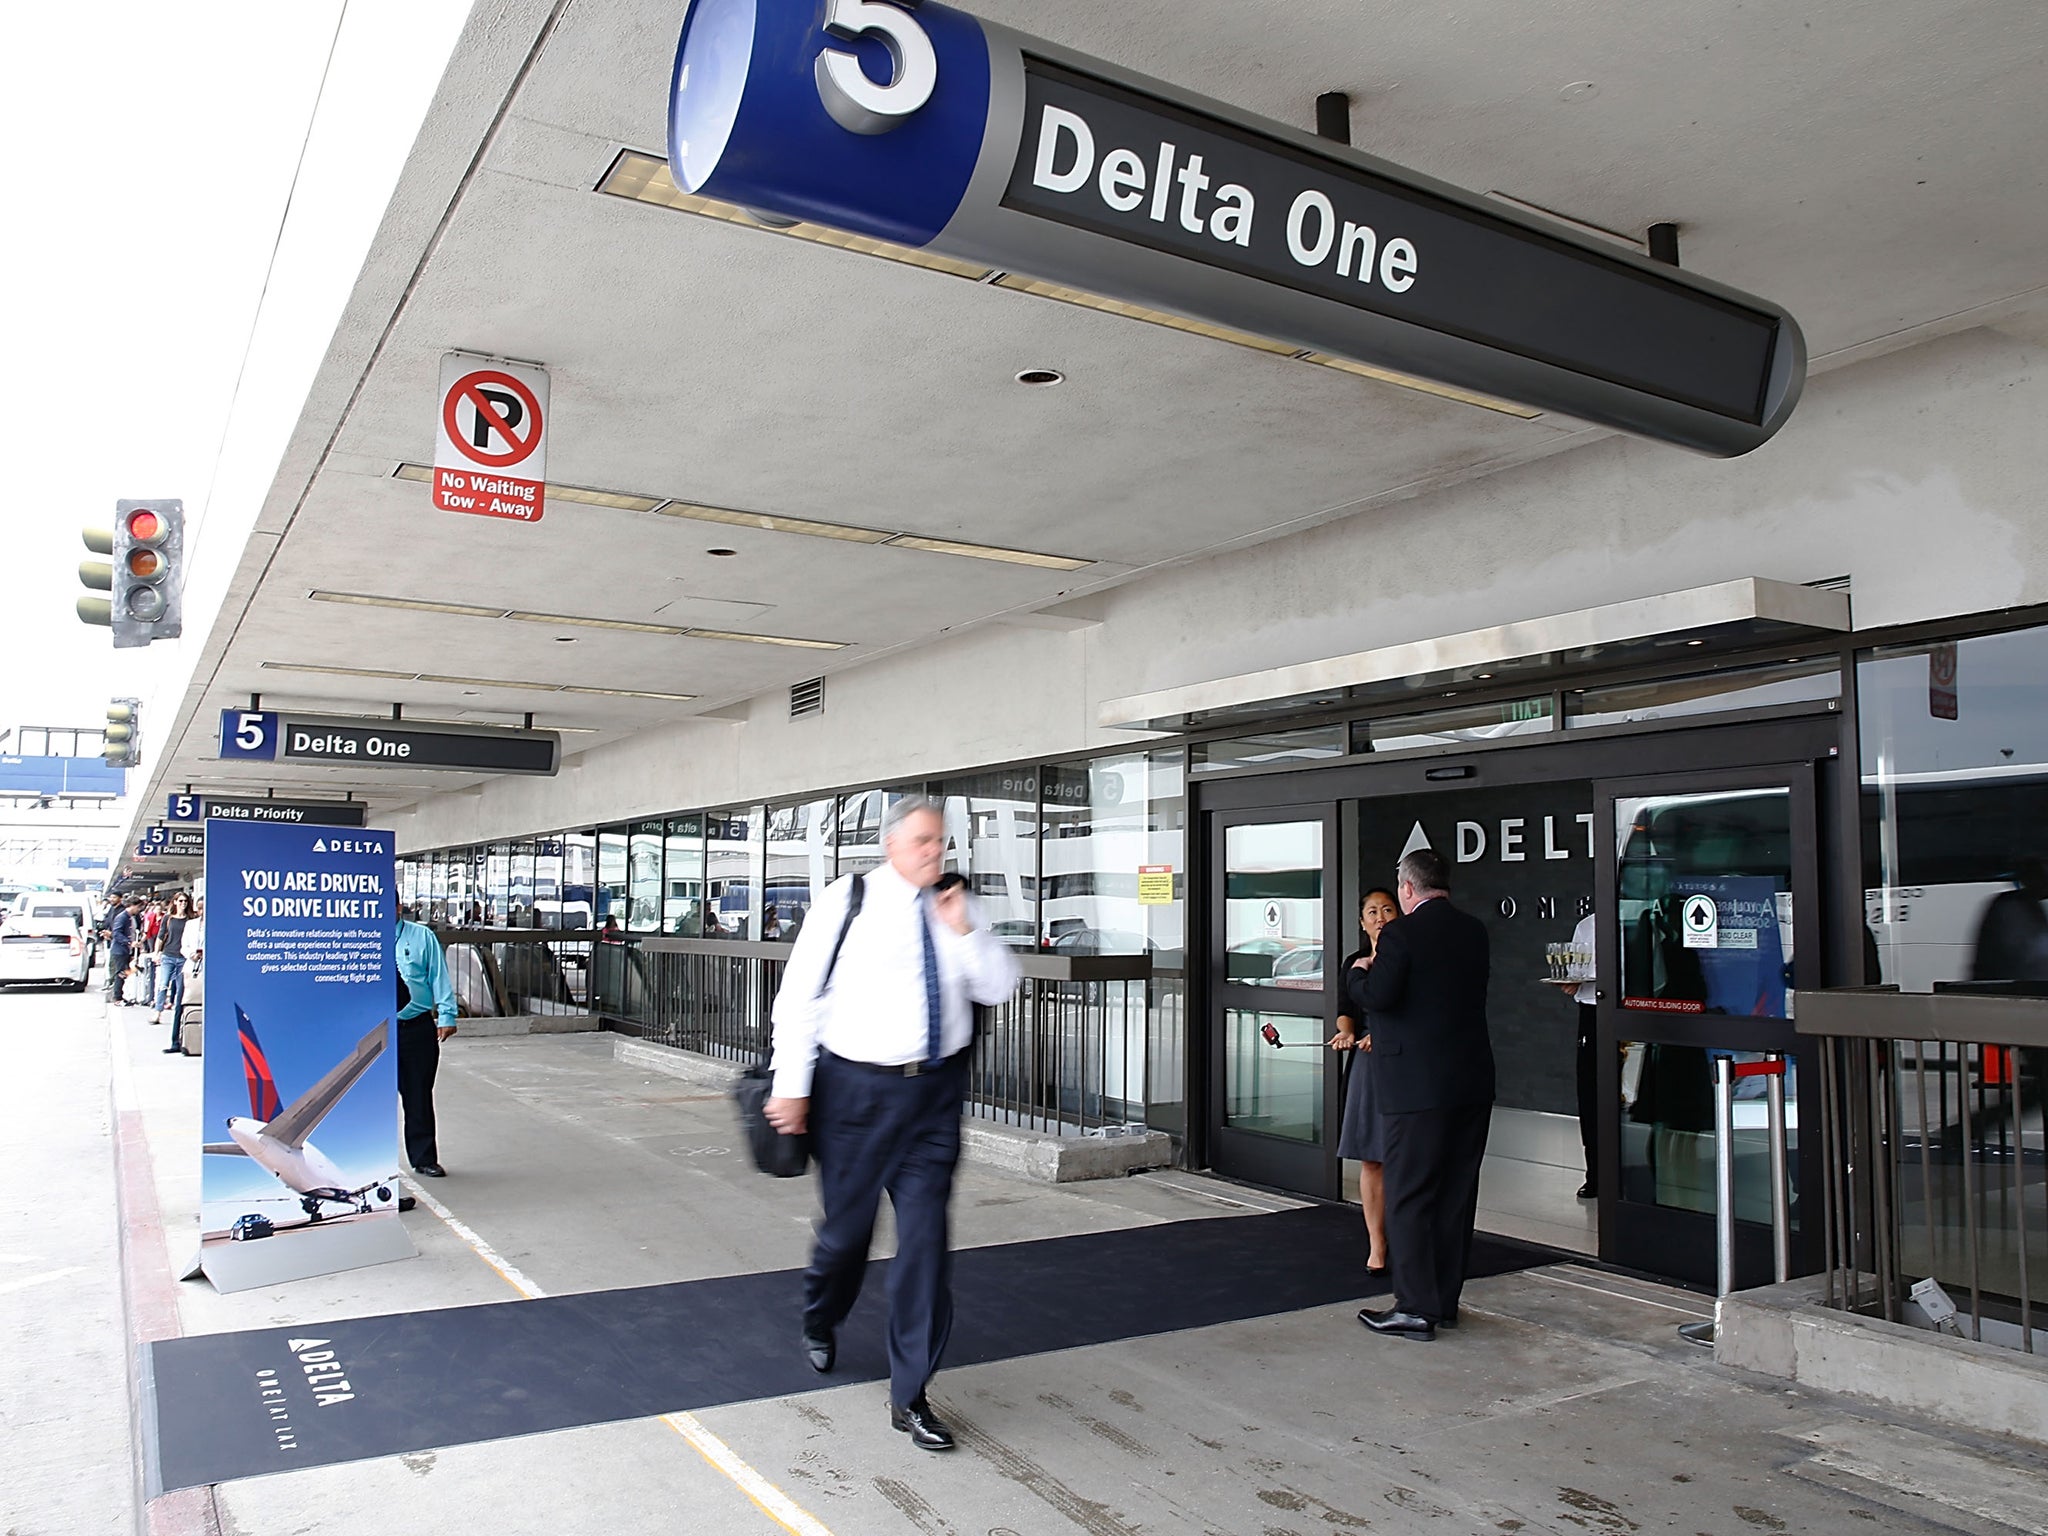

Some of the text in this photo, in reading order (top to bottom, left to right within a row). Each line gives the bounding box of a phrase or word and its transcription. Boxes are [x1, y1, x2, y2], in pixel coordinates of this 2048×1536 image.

[815, 0, 1419, 294] 5 Delta One
[441, 473, 536, 502] No Waiting
[440, 491, 476, 509] Tow
[488, 498, 535, 520] Away
[235, 713, 411, 758] 5 Delta One
[175, 796, 304, 822] 5 Delta Priority
[151, 828, 202, 844] 5 Delta
[1456, 813, 1595, 863] DELT
[143, 842, 204, 855] 5 Delta Shu
[331, 839, 383, 854] DELTA
[240, 869, 384, 896] YOU ARE DRIVEN,
[242, 896, 384, 919] SO DRIVE LIKE IT.
[247, 928, 382, 939] Delta's innovative relationship with Porsche
[1732, 931, 1753, 940] CLEAR
[247, 940, 267, 949] offers
[273, 941, 296, 951] unique
[296, 941, 331, 950] experience
[332, 940, 342, 949] for
[342, 941, 382, 951] unsuspecting
[246, 951, 382, 962] customers. This industry leading VIP service
[261, 963, 280, 973] gives
[280, 962, 308, 972] selected
[308, 963, 341, 971] customers
[346, 962, 359, 971] ride
[359, 963, 367, 971] to
[367, 962, 382, 971] their
[314, 974, 349, 983] connecting
[349, 973, 366, 983] flight
[1624, 999, 1701, 1011] AUTOMATIC SLIDING DOOR
[256, 1369, 282, 1397] ONE
[298, 1350, 355, 1407] DELTA
[269, 1407, 289, 1420] AT
[274, 1426, 298, 1450] LAX
